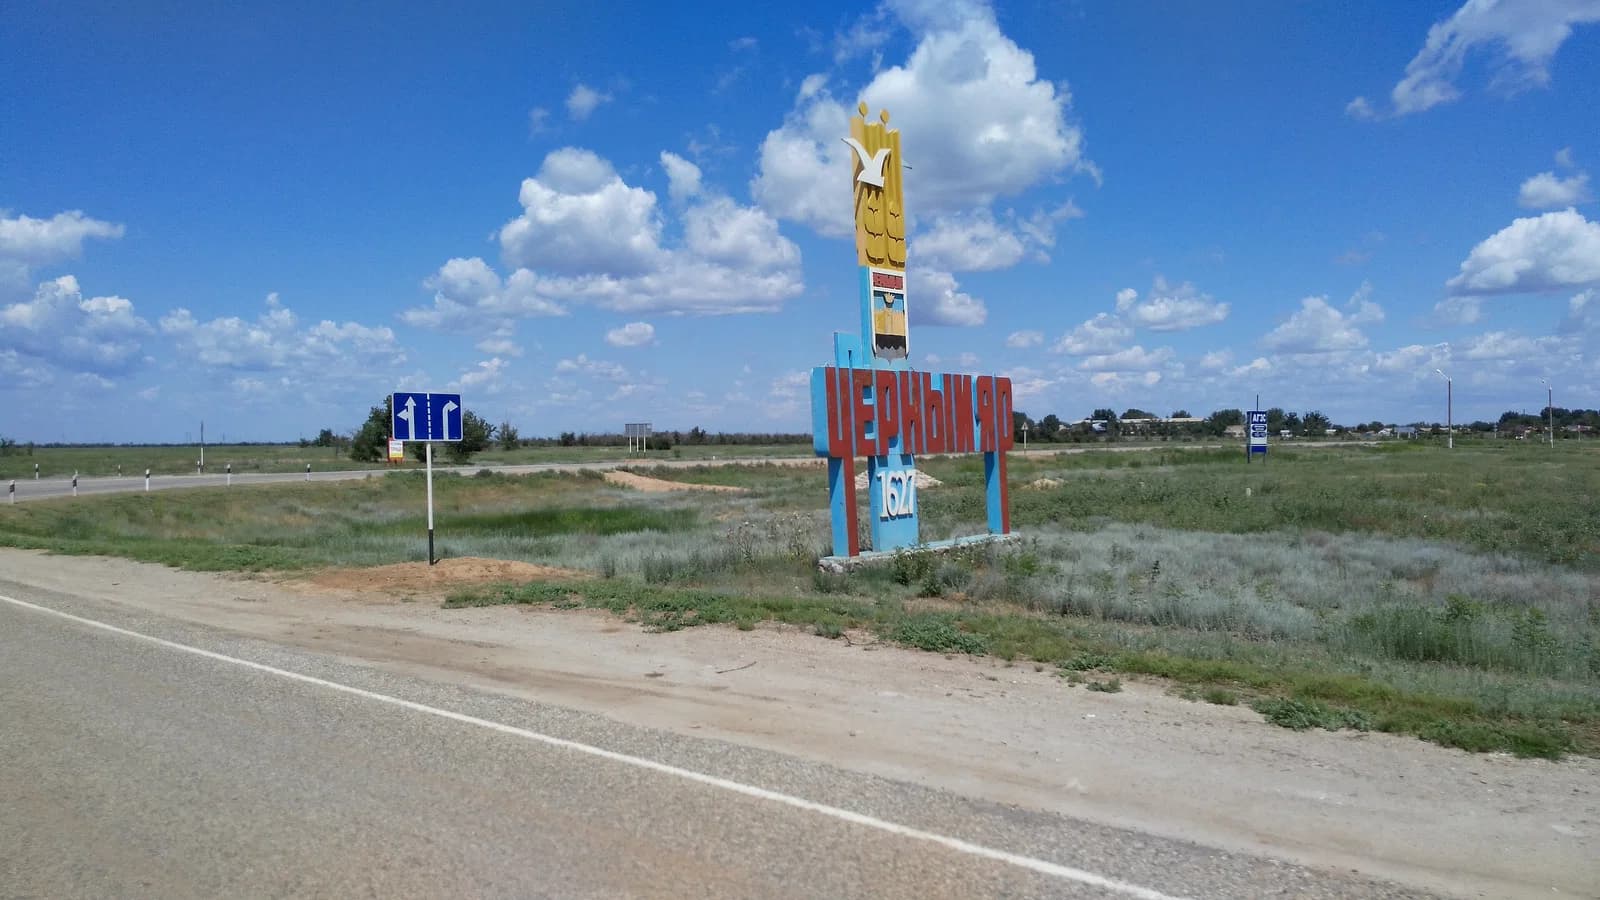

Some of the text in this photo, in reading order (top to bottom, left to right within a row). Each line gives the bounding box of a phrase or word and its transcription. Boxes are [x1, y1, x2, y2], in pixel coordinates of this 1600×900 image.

[825, 367, 1014, 458] ЧЕРНЫЙ ЯР
[877, 469, 915, 521] 1627
